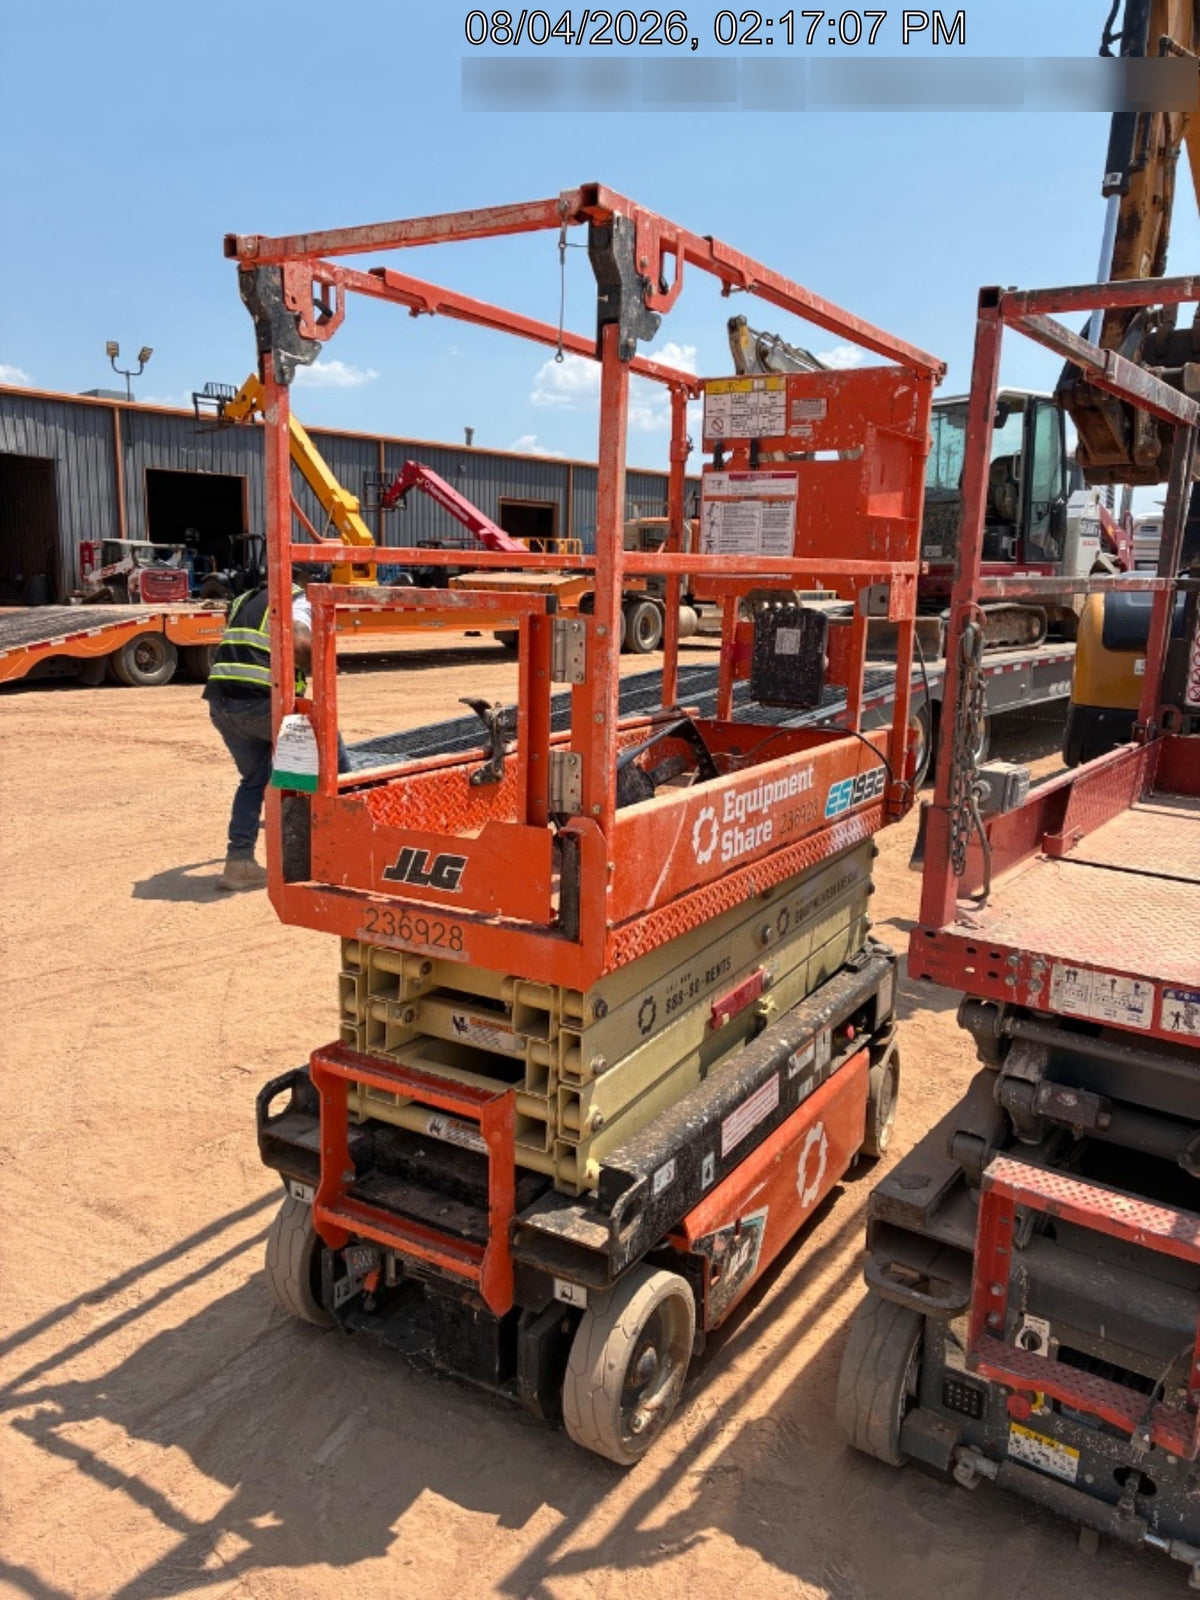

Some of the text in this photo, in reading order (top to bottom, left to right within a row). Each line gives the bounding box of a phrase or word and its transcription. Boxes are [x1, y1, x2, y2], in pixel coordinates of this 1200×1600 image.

[721, 763, 814, 823] Equipment
[720, 818, 773, 863] Share
[382, 845, 469, 893] JLG
[365, 907, 464, 952] 236928
